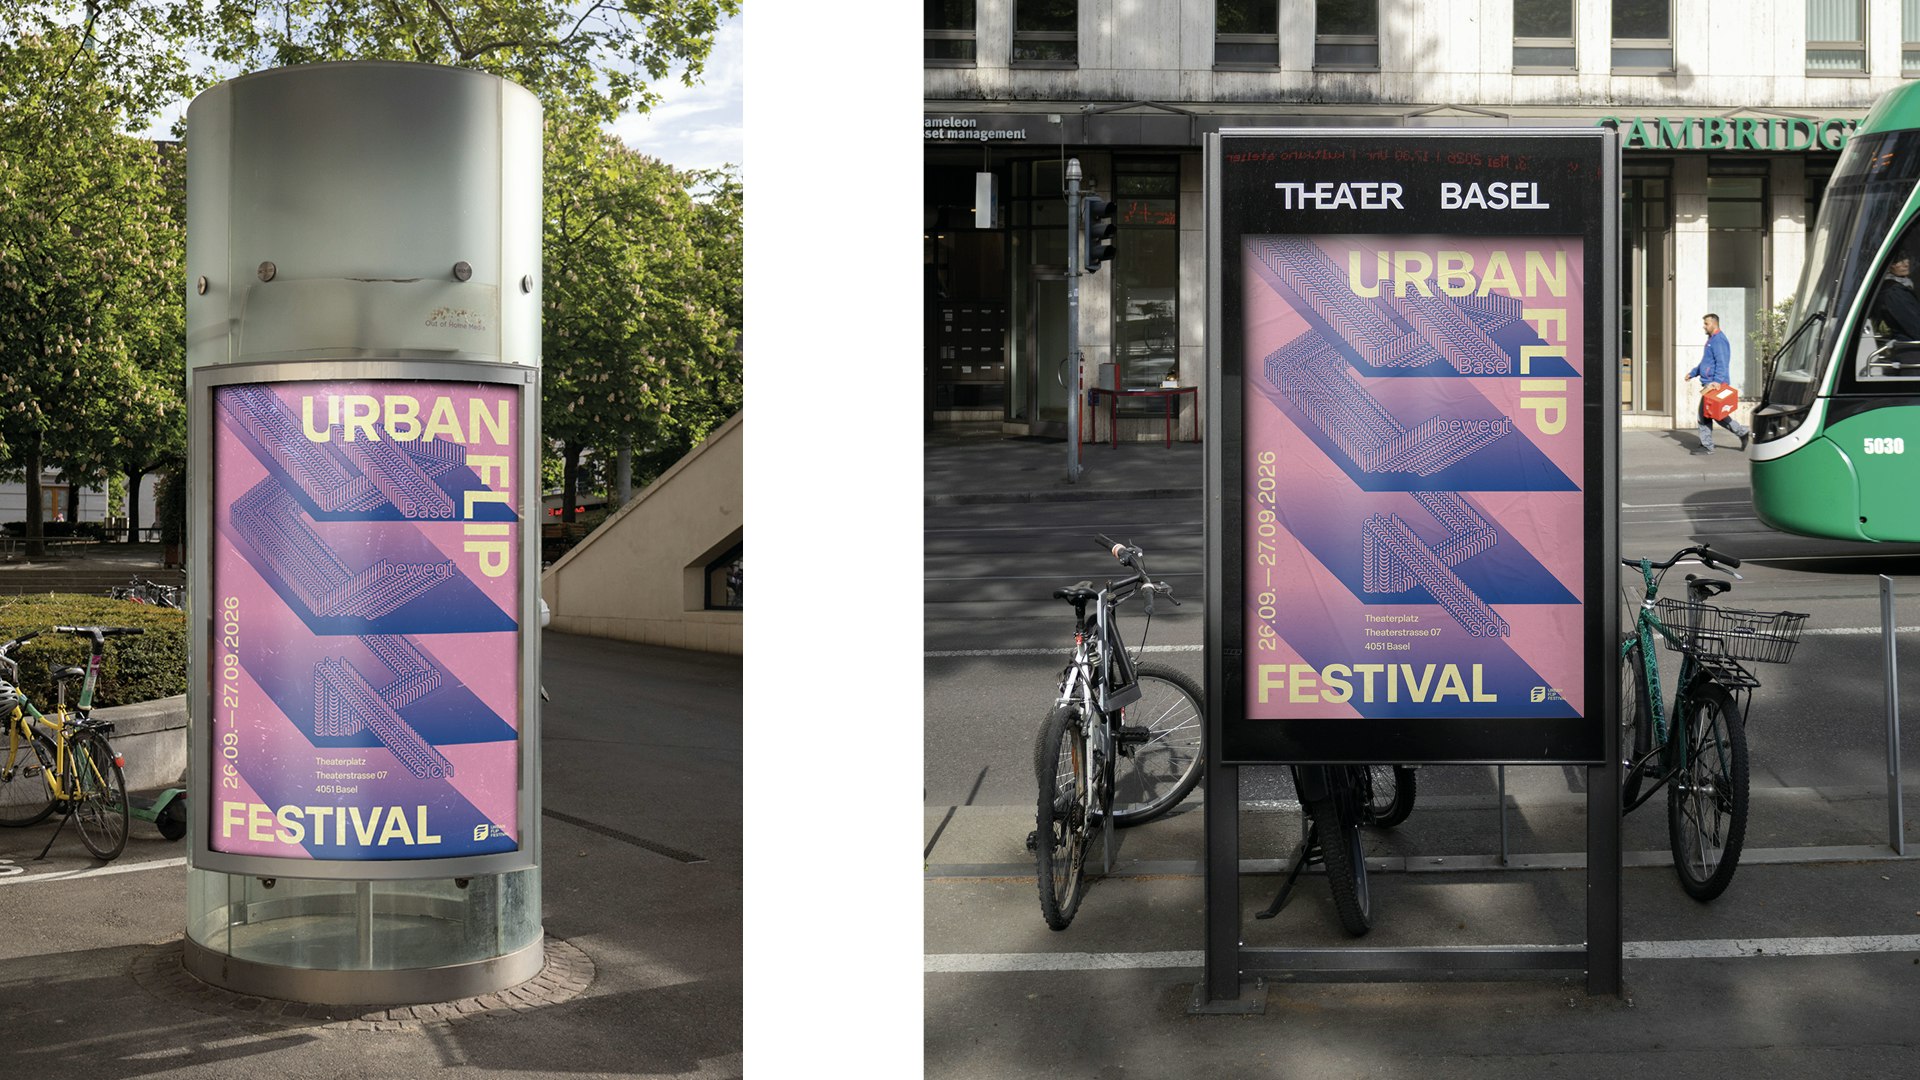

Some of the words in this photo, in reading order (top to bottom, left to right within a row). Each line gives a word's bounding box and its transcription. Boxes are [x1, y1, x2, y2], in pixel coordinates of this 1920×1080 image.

[923, 128, 944, 139] set
[947, 128, 1027, 141] management
[1596, 115, 1862, 150] AMBRIDG
[1275, 182, 1404, 210] THEATER
[1441, 182, 1550, 210] BASEL
[1348, 250, 1567, 298] URBAN
[1458, 357, 1512, 375] Basel
[1519, 308, 1567, 435] FLIP
[302, 395, 510, 446] URBAN
[1437, 416, 1512, 438] bewegt
[1863, 437, 1904, 455] 5030
[404, 500, 456, 519] Basel
[463, 454, 510, 578] FLIP
[383, 560, 456, 581] bewegt
[1364, 614, 1419, 624] Theaterplatz
[1364, 628, 1429, 637] Theaterstrasse
[1430, 628, 1442, 637] 07
[1364, 642, 1385, 651] 4051
[1386, 642, 1411, 651] Basel
[1257, 663, 1498, 704] FESTIVAL
[315, 757, 366, 767] Theaterplatz
[315, 771, 376, 780] Theaterstrasse
[377, 771, 388, 780] 07
[315, 785, 335, 794] 4051
[336, 785, 358, 794] Basel
[222, 801, 442, 846] FESTIVAL
